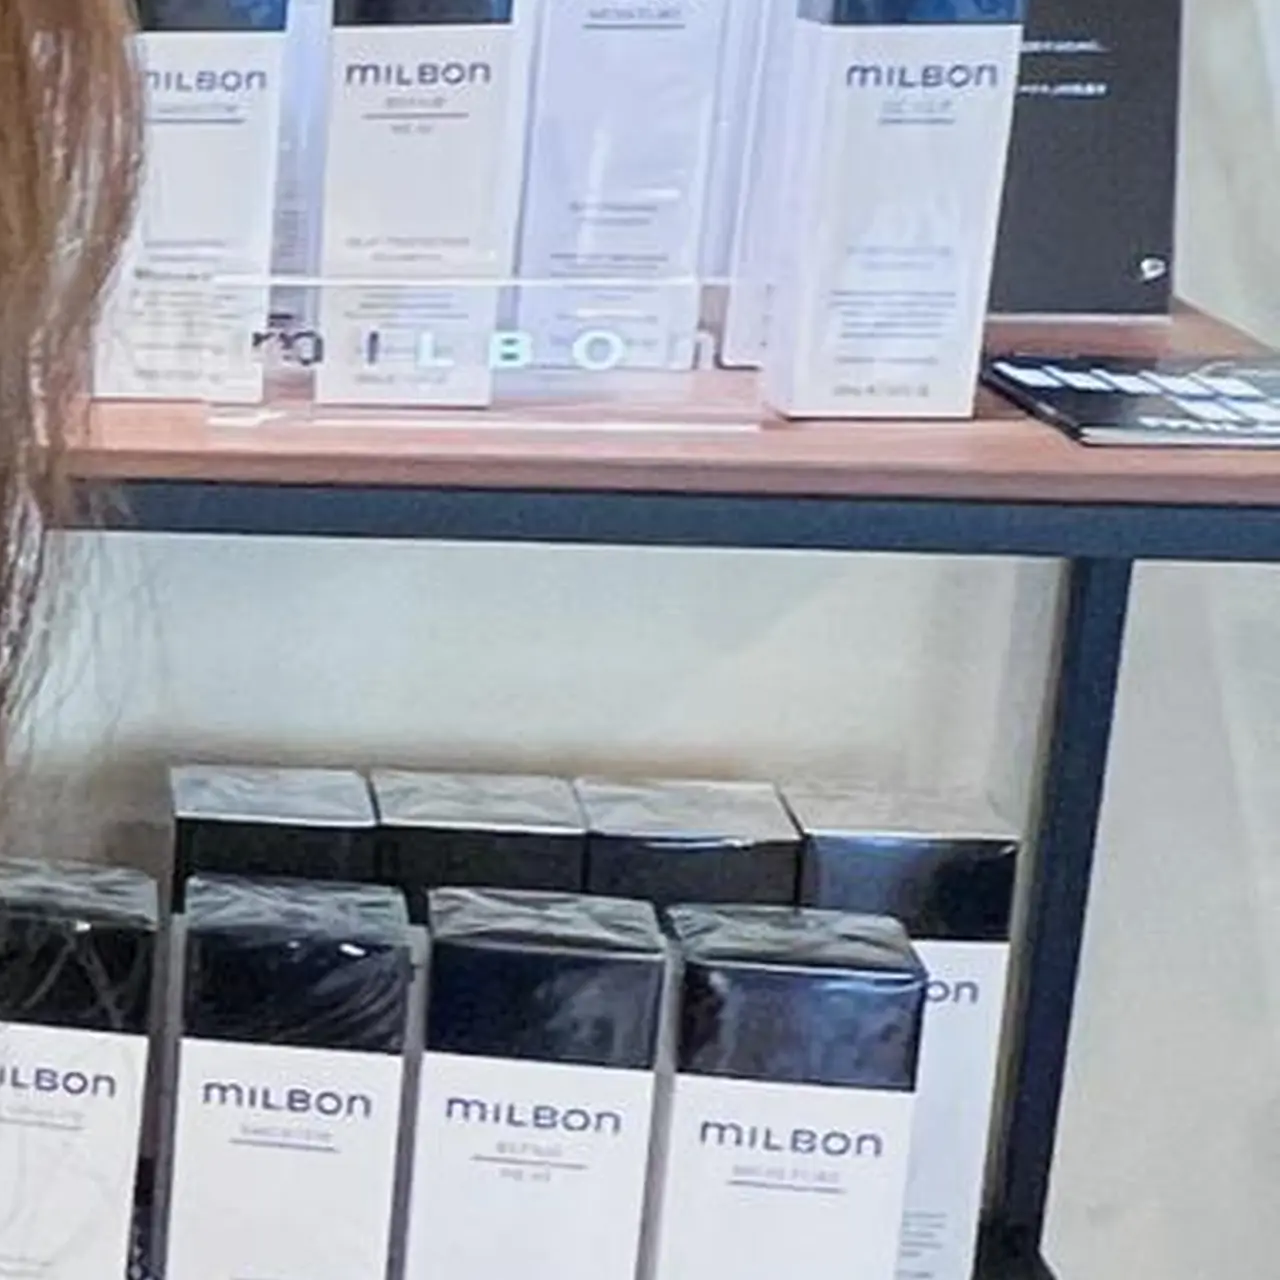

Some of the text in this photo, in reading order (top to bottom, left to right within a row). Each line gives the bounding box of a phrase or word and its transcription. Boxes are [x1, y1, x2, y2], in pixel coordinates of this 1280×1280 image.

[345, 62, 492, 87] MILBON
[846, 64, 999, 89] MILBON
[201, 1081, 373, 1119] MILBON
[445, 1097, 622, 1135] MILBON
[699, 1120, 883, 1158] MILBON
